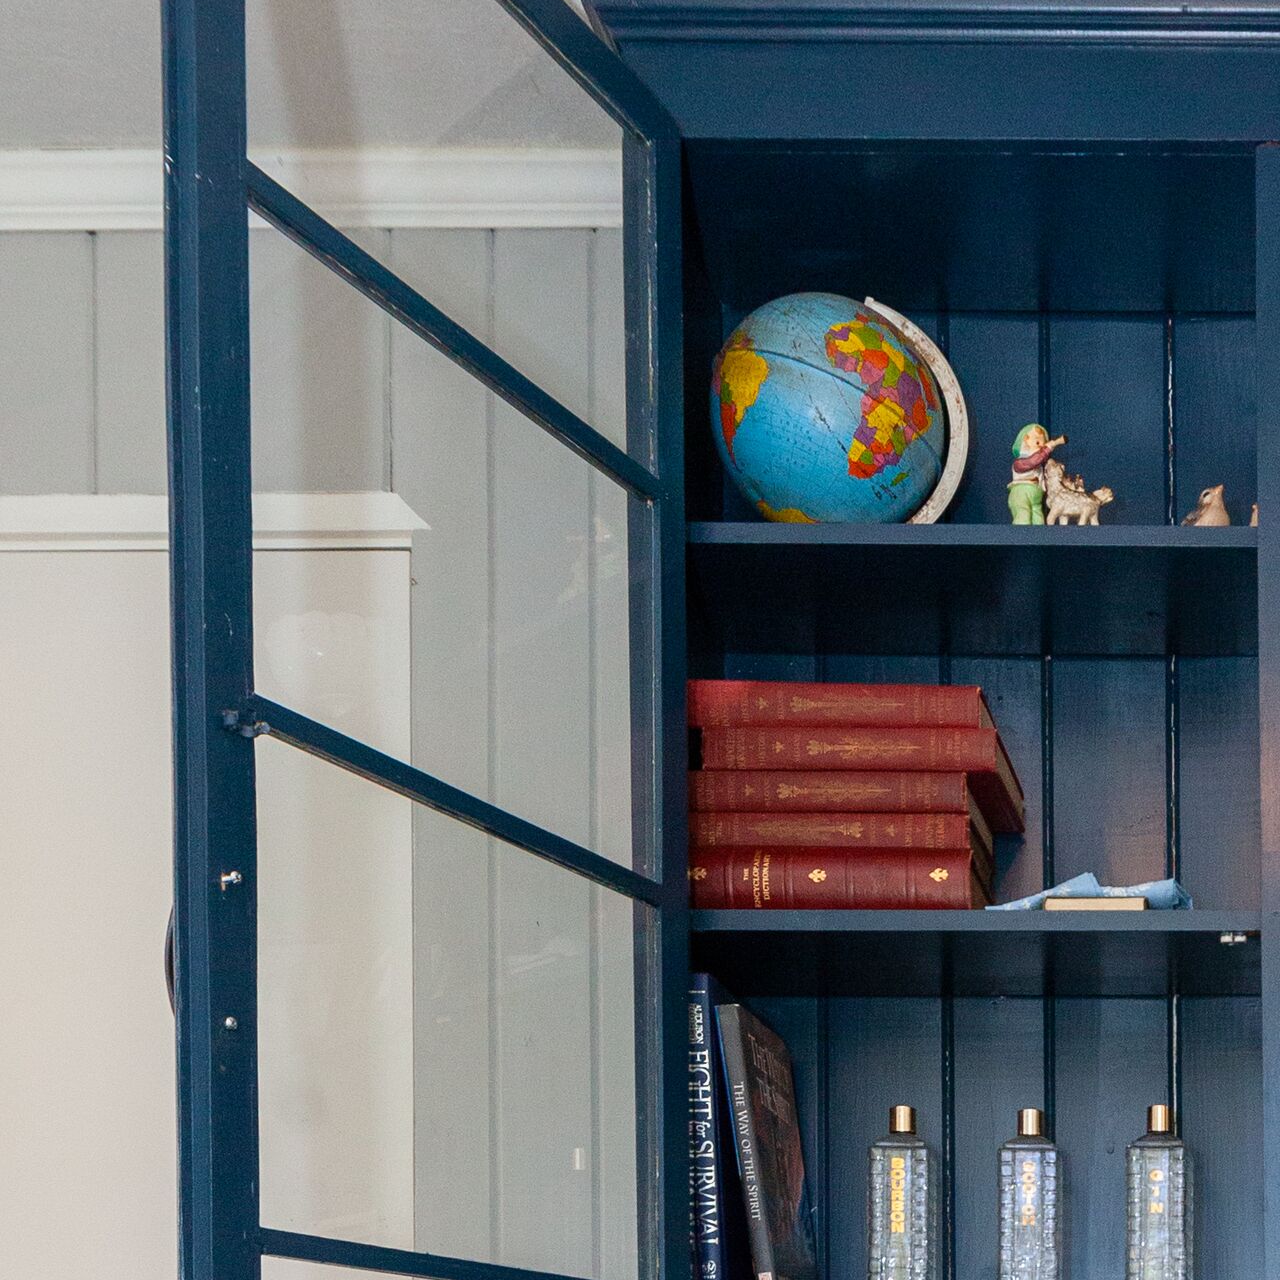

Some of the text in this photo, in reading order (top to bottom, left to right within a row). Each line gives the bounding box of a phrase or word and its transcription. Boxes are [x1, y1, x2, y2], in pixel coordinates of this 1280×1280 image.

[694, 1004, 704, 1044] AUDUBON
[694, 1049, 712, 1119] FIGHT
[694, 1121, 711, 1138] for
[733, 1081, 761, 1221] THE WAY OF THE SPIRIT
[891, 1157, 906, 1233] BOURBON
[1022, 1162, 1037, 1226] SCOTCH
[1149, 1169, 1164, 1214] GIN
